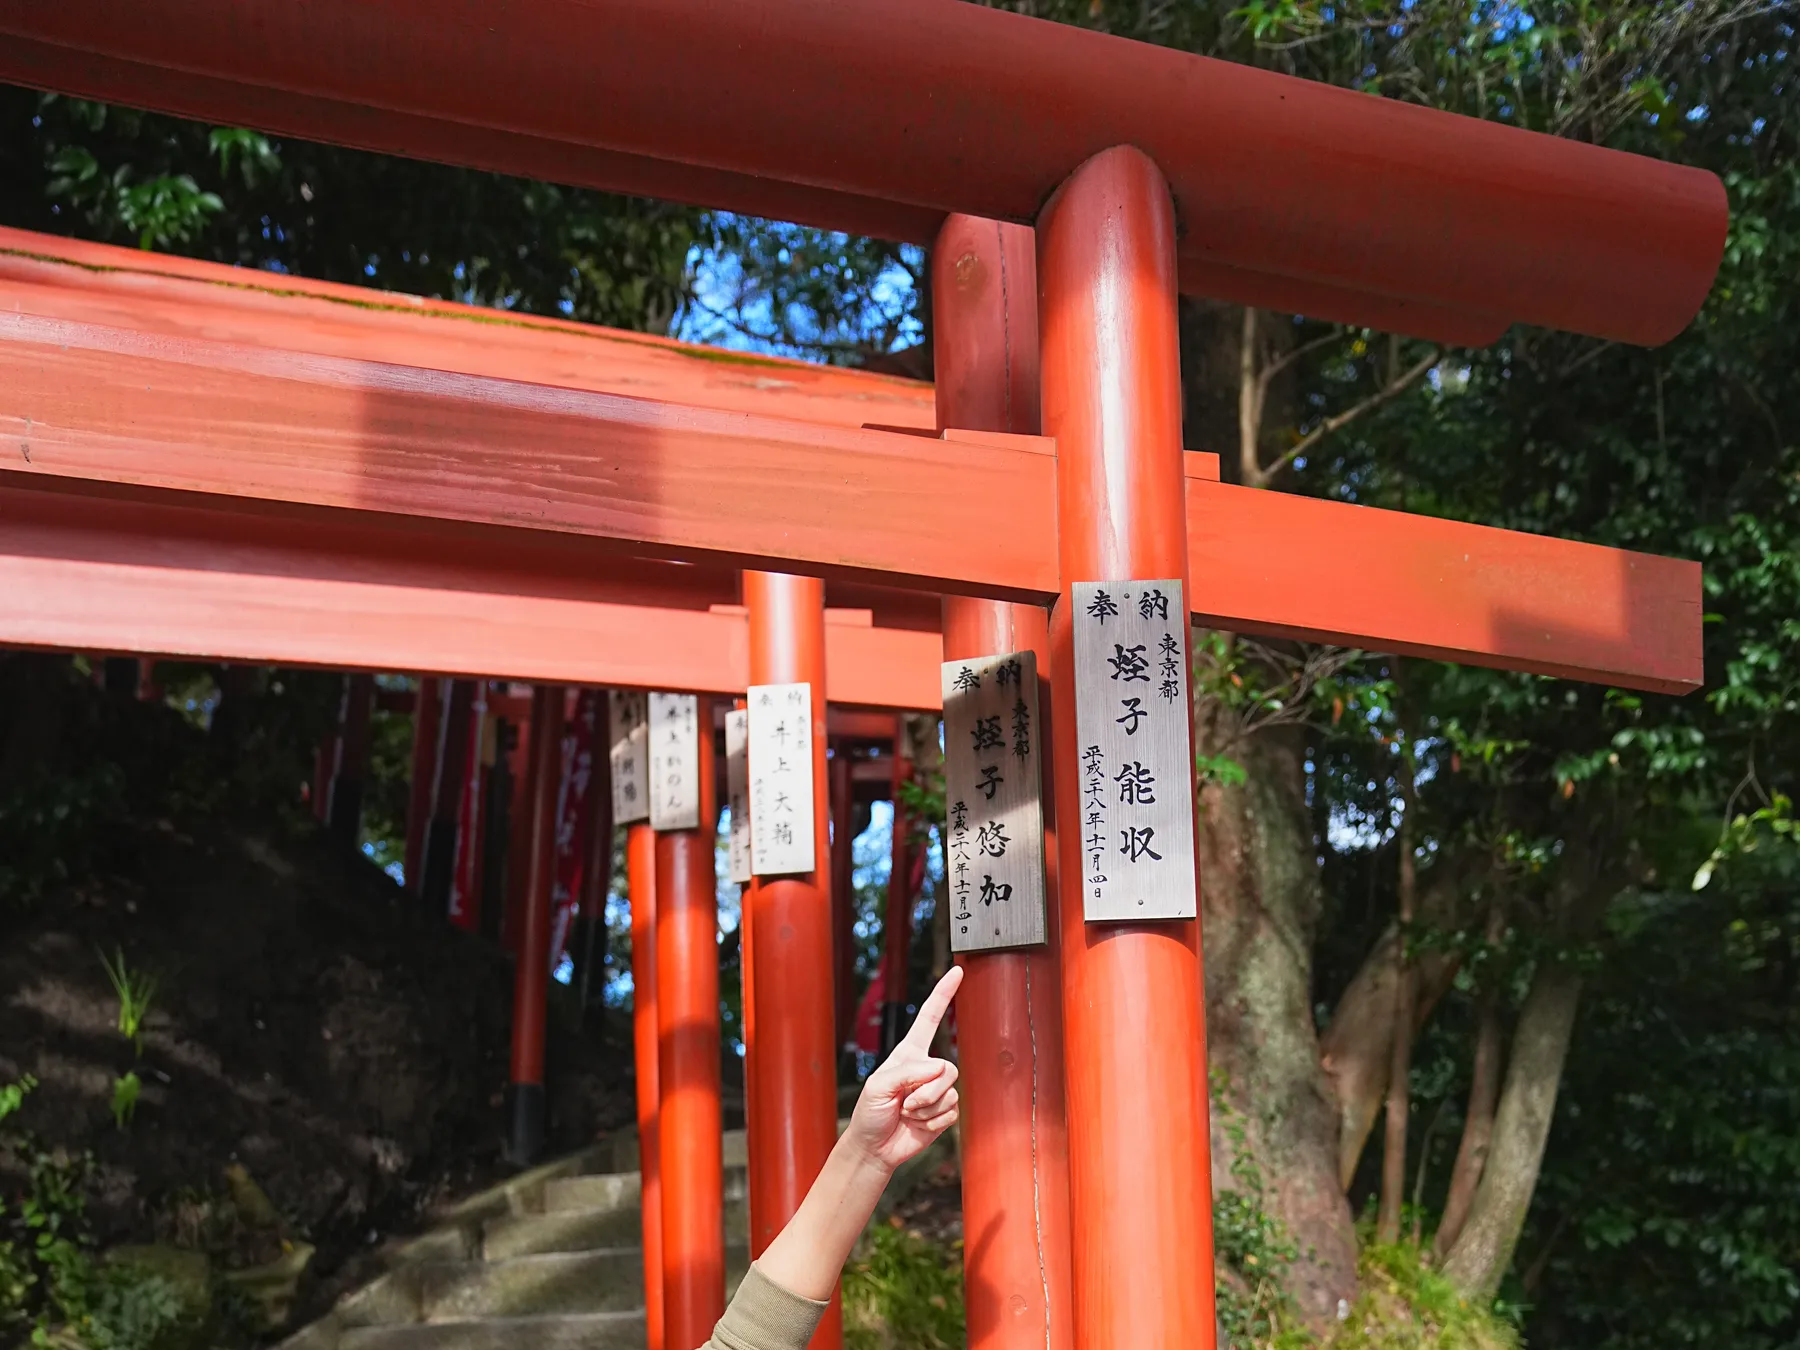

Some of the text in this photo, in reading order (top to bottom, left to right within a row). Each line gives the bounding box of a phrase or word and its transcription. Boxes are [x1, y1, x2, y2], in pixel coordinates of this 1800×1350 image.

[1087, 589, 1169, 625] 奉納
[952, 659, 1022, 694] 奉納
[1158, 633, 1181, 705] 東京都
[1012, 698, 1030, 761] 東京都
[1107, 643, 1163, 864] 蛭子能収
[970, 715, 1013, 907] 蛭子悠加
[1082, 745, 1108, 898] 平成二十八年十一月四日
[950, 801, 972, 934] 平成二十八年十一月四日
